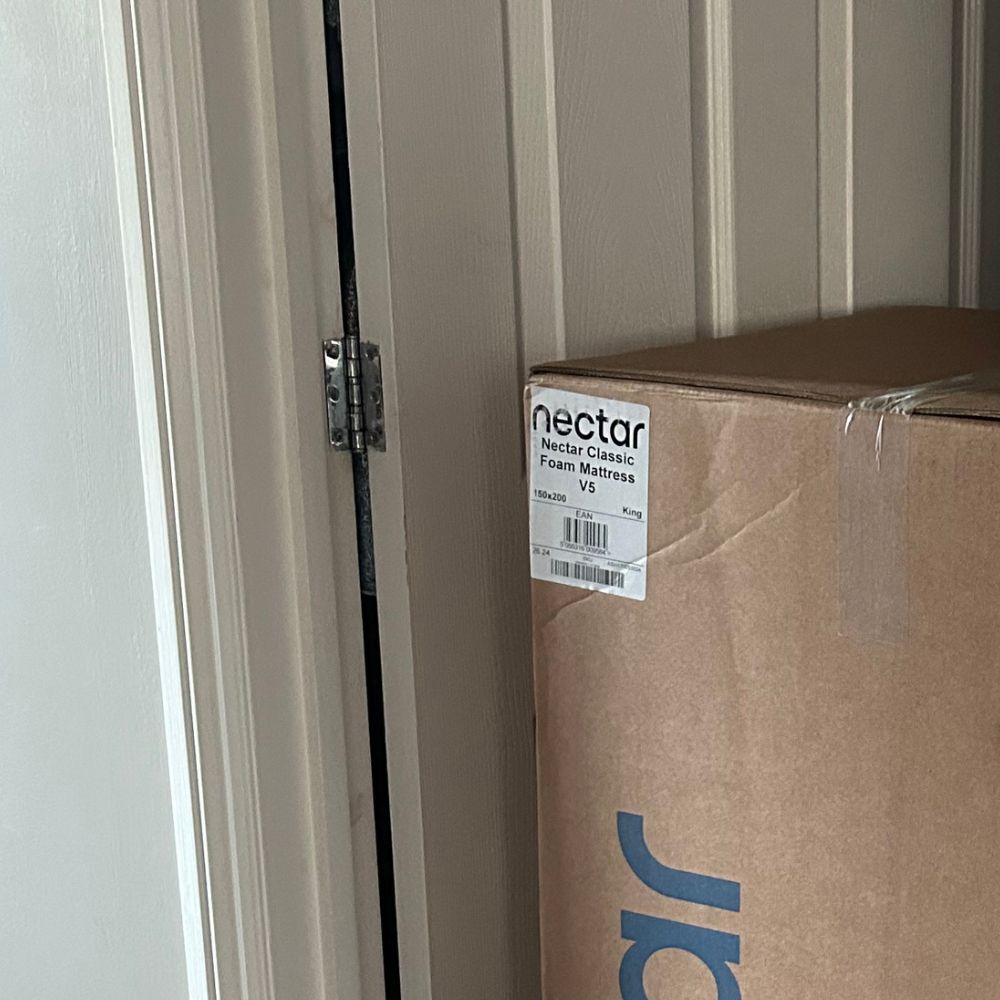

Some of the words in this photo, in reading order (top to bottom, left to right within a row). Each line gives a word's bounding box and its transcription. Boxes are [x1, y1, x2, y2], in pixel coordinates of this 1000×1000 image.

[532, 404, 645, 450] nectar
[541, 437, 584, 456] Nectar
[587, 446, 635, 466] Classic
[540, 455, 575, 473] Foam
[579, 462, 635, 484] Mattress
[579, 479, 596, 494] V5
[534, 489, 567, 503] 150x200
[575, 510, 593, 520] EAN
[622, 506, 642, 519] King
